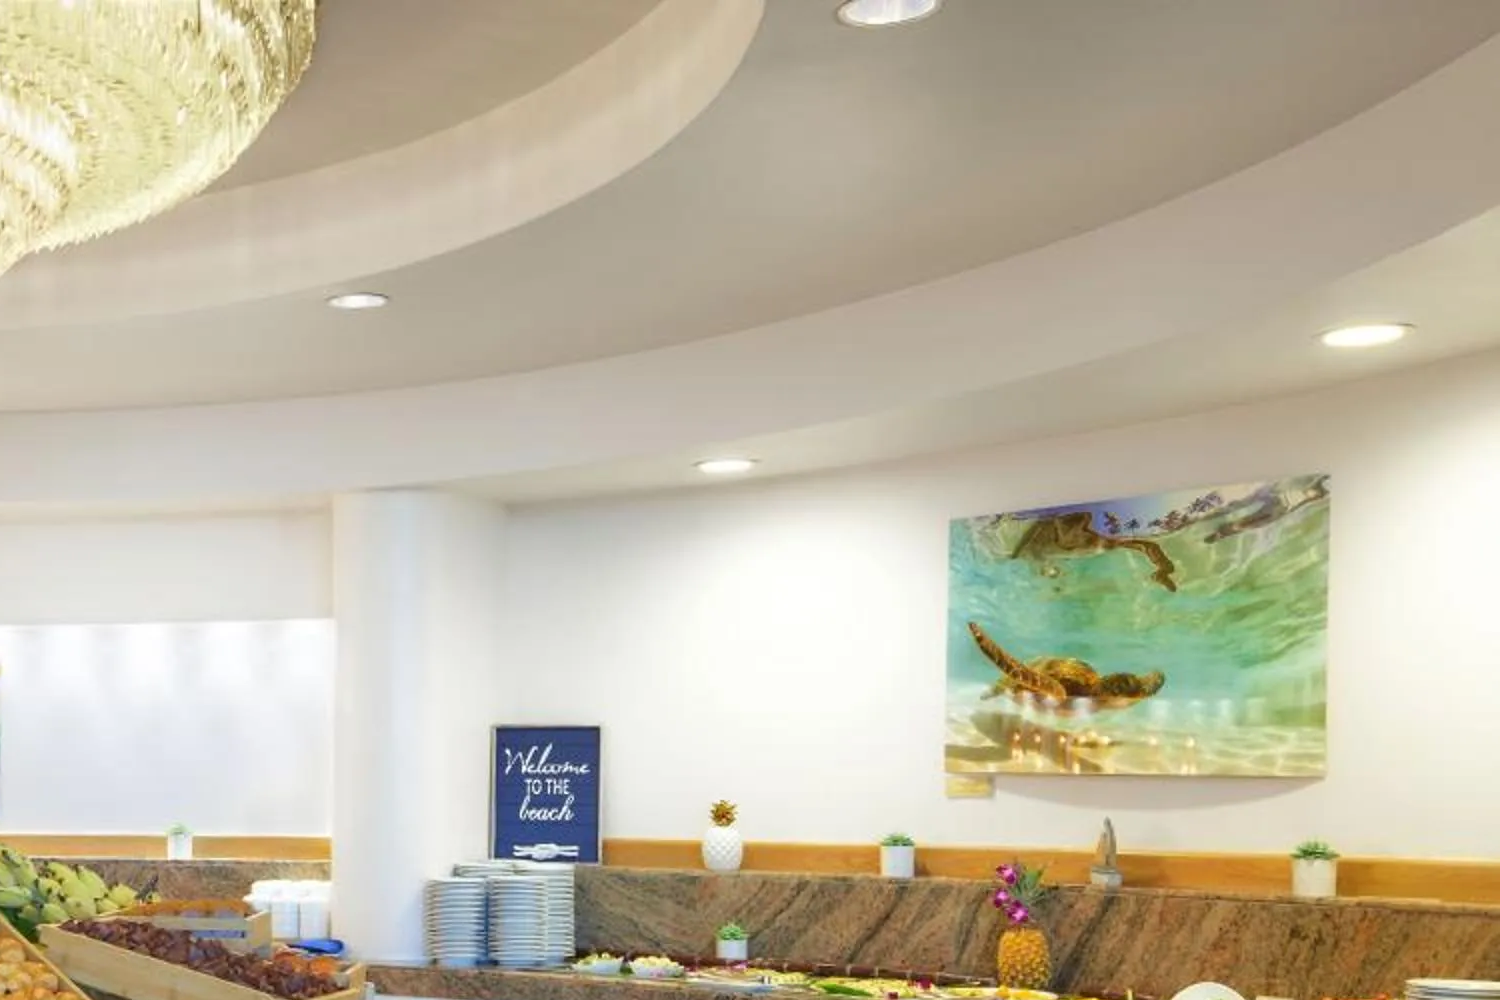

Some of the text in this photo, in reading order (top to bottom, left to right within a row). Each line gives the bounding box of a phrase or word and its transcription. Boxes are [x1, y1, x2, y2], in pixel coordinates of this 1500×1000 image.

[504, 742, 590, 775] Welcome
[524, 778, 571, 795] TO THE
[519, 794, 574, 821] beach
